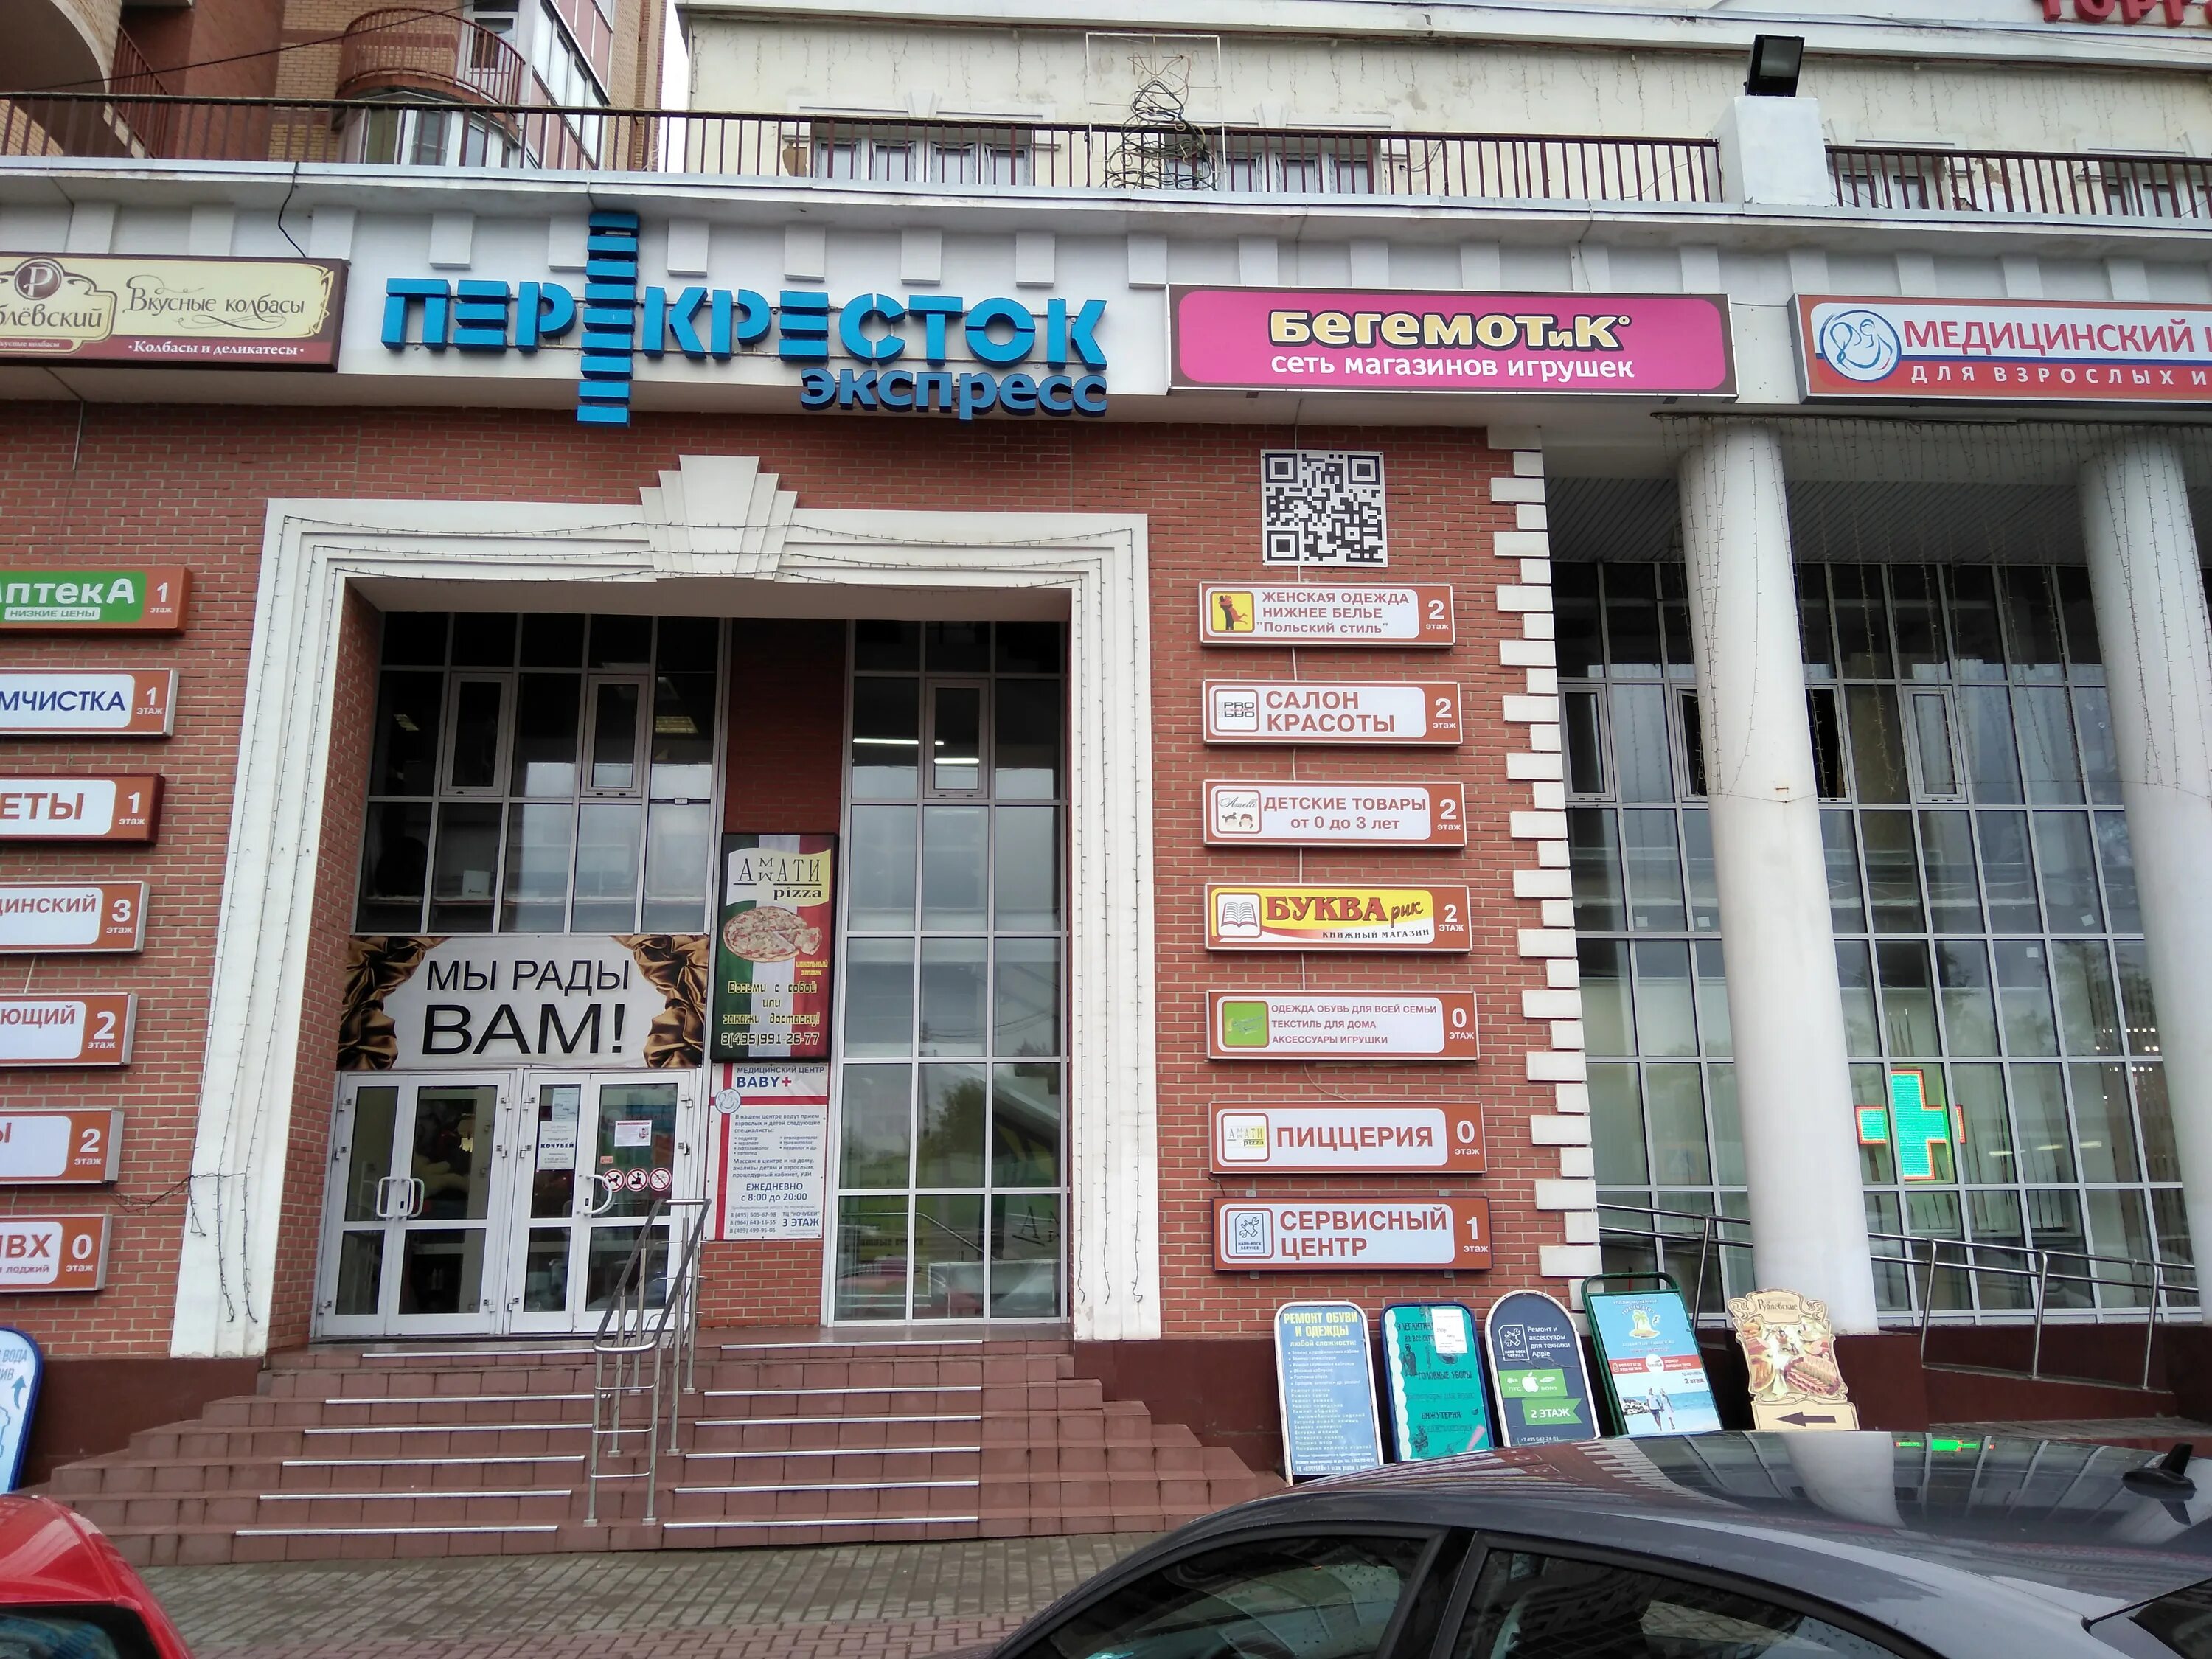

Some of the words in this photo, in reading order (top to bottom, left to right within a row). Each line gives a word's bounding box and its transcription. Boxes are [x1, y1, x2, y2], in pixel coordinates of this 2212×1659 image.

[122, 276, 216, 316] Вкусные
[225, 293, 305, 316] колбасы
[1903, 319, 2194, 355] МЕДИЦИНСКИЙ
[133, 341, 197, 353] Колбасы
[201, 344, 210, 353] и
[213, 344, 297, 355] деликатесы
[1271, 354, 1335, 374] сеть
[1344, 357, 1498, 377] магазинов
[1507, 358, 1635, 383] игрушек
[1910, 366, 1975, 383] ДЛЯ
[1995, 367, 2174, 385] ВЗРОСЛЫХ
[2193, 372, 2207, 386] И
[801, 368, 1107, 421] экспресс
[0, 578, 135, 605] птекА
[156, 582, 168, 602] 1
[1262, 591, 1335, 604] ЖЕНСКАЯ
[1340, 592, 1410, 605] ОДЕЖДА
[60, 610, 96, 618] ЦЕНЫ
[1262, 607, 1327, 618] НИЖНЕЕ
[1332, 608, 1382, 619] БЕЛЬЕ
[1427, 599, 1445, 620] 2
[146, 687, 157, 706] 1
[1265, 690, 1359, 709] САЛОН
[1434, 698, 1453, 718] 2
[1267, 713, 1395, 733] КРАСОТЫ
[128, 792, 140, 813] 1
[1264, 796, 1346, 812] ДЕТСКИЕ
[1352, 798, 1427, 811] ТОВАРЫ
[1439, 799, 1458, 820] 2
[1290, 818, 1310, 829] от
[1314, 815, 1326, 829] 0
[1329, 818, 1351, 831] до
[1356, 816, 1367, 830] 3
[1371, 818, 1400, 830] лет
[773, 887, 822, 901] pizza
[0, 894, 97, 917] ИНСКИЙ
[111, 899, 131, 922] 3
[1444, 904, 1458, 922] 2
[1322, 930, 1377, 939] КНИЖНЫЙ
[1381, 928, 1430, 939] МАГАЗИН
[1439, 924, 1464, 932] ЭТАЖ
[426, 960, 497, 991] МЫ
[512, 960, 630, 997] РАДЫ
[728, 981, 767, 994] Возьми
[774, 984, 779, 992] с
[787, 980, 818, 994] собой
[762, 999, 781, 1008] или
[1270, 1005, 1315, 1015] ОДЕЖДА
[1317, 1005, 1350, 1014] ОБУВЬ
[1351, 1005, 1372, 1015] ДЛЯ
[1374, 1004, 1401, 1014] ВСЕЙ
[1402, 1005, 1437, 1014] СЕМЬИ
[93, 1010, 116, 1040] 2
[723, 1014, 761, 1025] закажи
[769, 1012, 821, 1027] доставку!
[1271, 1020, 1322, 1029] ТЕКСТИЛЬ
[1324, 1020, 1346, 1029] ДЛЯ
[1347, 1020, 1377, 1030] ДОМА
[1451, 1007, 1467, 1029] 0
[421, 1004, 626, 1056] ВАМ!
[1448, 1032, 1475, 1040] ЭТАЖ
[1271, 1034, 1339, 1045] АКСЕССУАРЫ
[1340, 1035, 1388, 1045] ИГРУШКИ
[737, 1065, 797, 1074] МЕДИЦИНСКИЙ
[1277, 1127, 1433, 1152] ПИЦЦЕРИЯ
[1456, 1119, 1475, 1144] 0
[80, 1128, 102, 1153] 2
[1454, 1147, 1480, 1156] этаж
[74, 1157, 102, 1165] этаж
[746, 1182, 803, 1192] ЕЖЕДНЕВНО
[748, 1193, 767, 1201] 8:00
[768, 1194, 781, 1203] до
[783, 1193, 807, 1201] 20:00
[782, 1218, 788, 1227] 3
[790, 1217, 820, 1227] ЭТАЖ
[1279, 1207, 1447, 1231] СЕРВИСНЫЙ
[1465, 1217, 1479, 1241] 1
[0, 1234, 52, 1259] ВХ
[72, 1234, 93, 1260] 0
[1281, 1237, 1368, 1262] ЦЕНТР
[1463, 1245, 1489, 1253] этаж
[6, 1265, 49, 1274] лоджий
[66, 1264, 94, 1273] этаж
[1284, 1312, 1323, 1324] РЕМОНТ
[1326, 1312, 1358, 1324] ОБУВИ
[1295, 1326, 1302, 1337] И
[1305, 1325, 1349, 1338] ОДЕЖДЫ
[1290, 1340, 1315, 1348] любой
[2, 1349, 28, 1363] ВОДА
[1530, 1409, 1537, 1419] 2
[1540, 1408, 1571, 1418] ЭТАЖ
